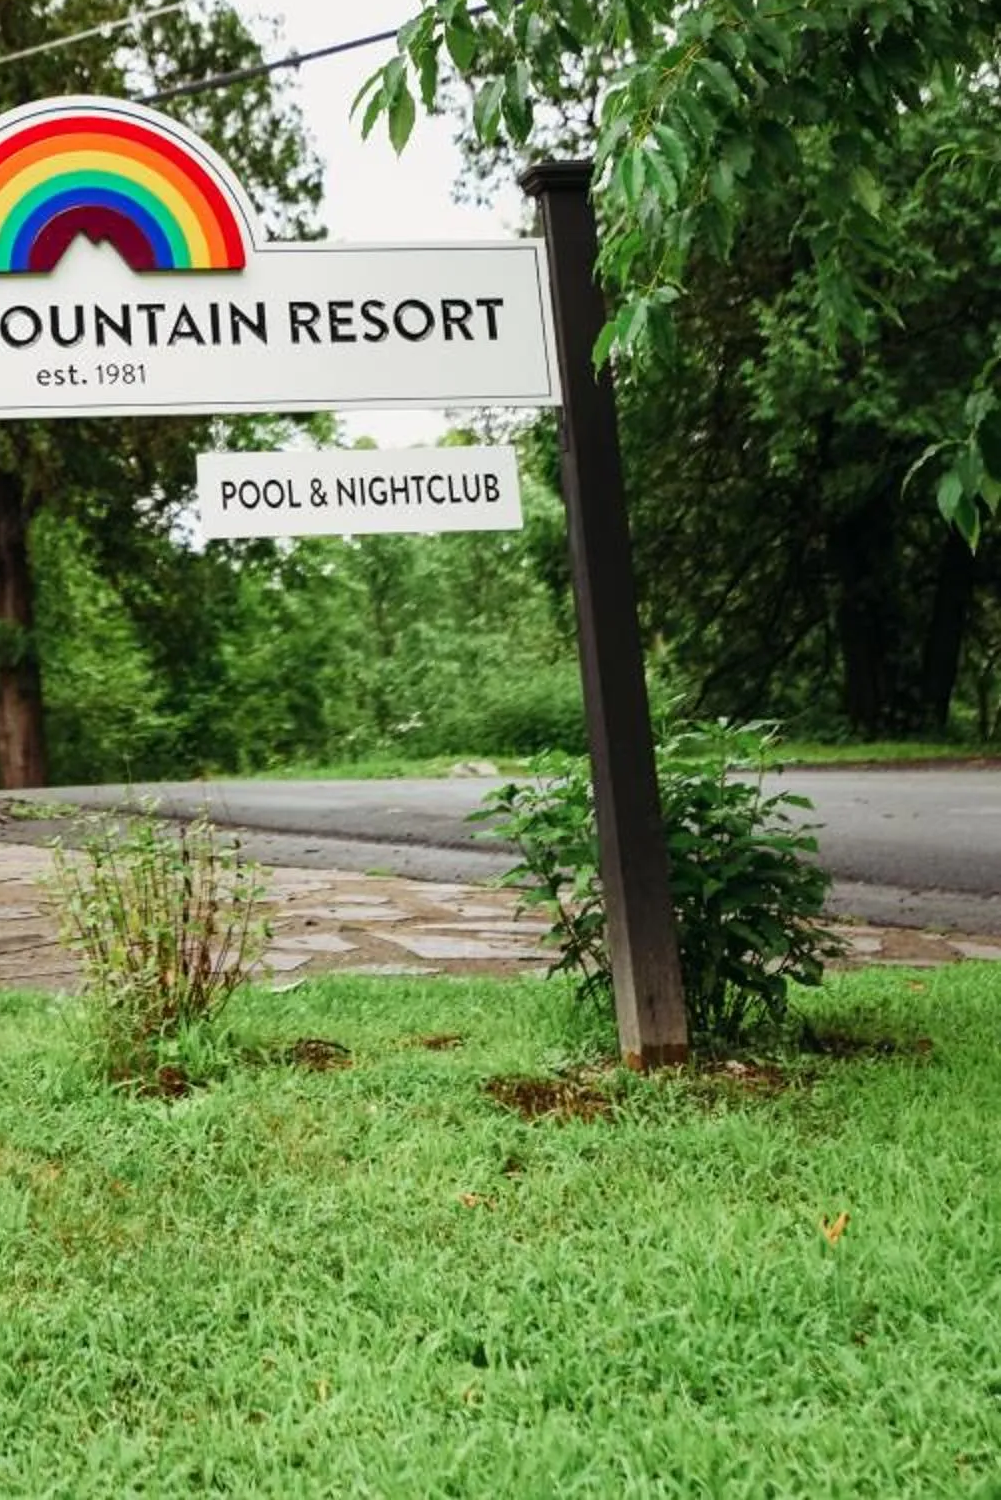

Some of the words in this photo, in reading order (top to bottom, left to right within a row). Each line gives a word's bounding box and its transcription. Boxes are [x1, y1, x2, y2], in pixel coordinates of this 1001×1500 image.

[288, 297, 504, 345] RESORT
[36, 364, 88, 387] est.
[96, 363, 146, 386] 1981
[220, 479, 302, 510] POOL
[310, 477, 328, 508] &
[336, 473, 501, 507] NIGHTCLUB
